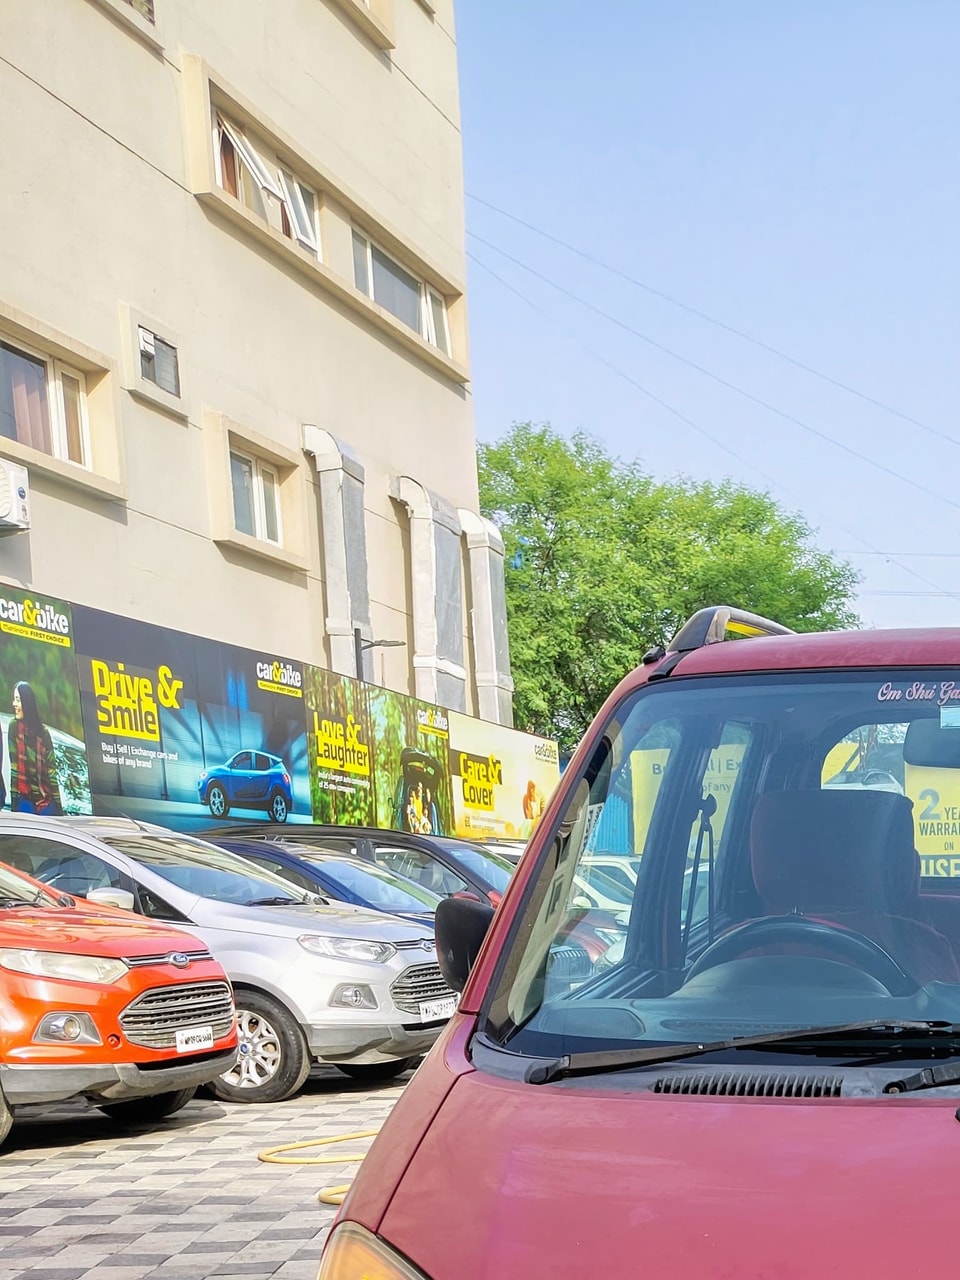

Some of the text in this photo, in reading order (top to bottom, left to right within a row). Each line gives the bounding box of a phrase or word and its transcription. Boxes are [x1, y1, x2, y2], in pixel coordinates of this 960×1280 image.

[0, 598, 69, 633] car&bike
[92, 659, 183, 709] Drive &
[256, 661, 302, 687] car&bike
[877, 682, 903, 701] Om
[96, 694, 157, 735] Smile
[314, 711, 361, 744] Love &
[117, 744, 127, 753] Sell
[316, 736, 368, 768] Laughter
[460, 753, 502, 785] Care &
[462, 778, 493, 806] Cover
[918, 788, 941, 821] 2
[944, 842, 954, 850] ON
